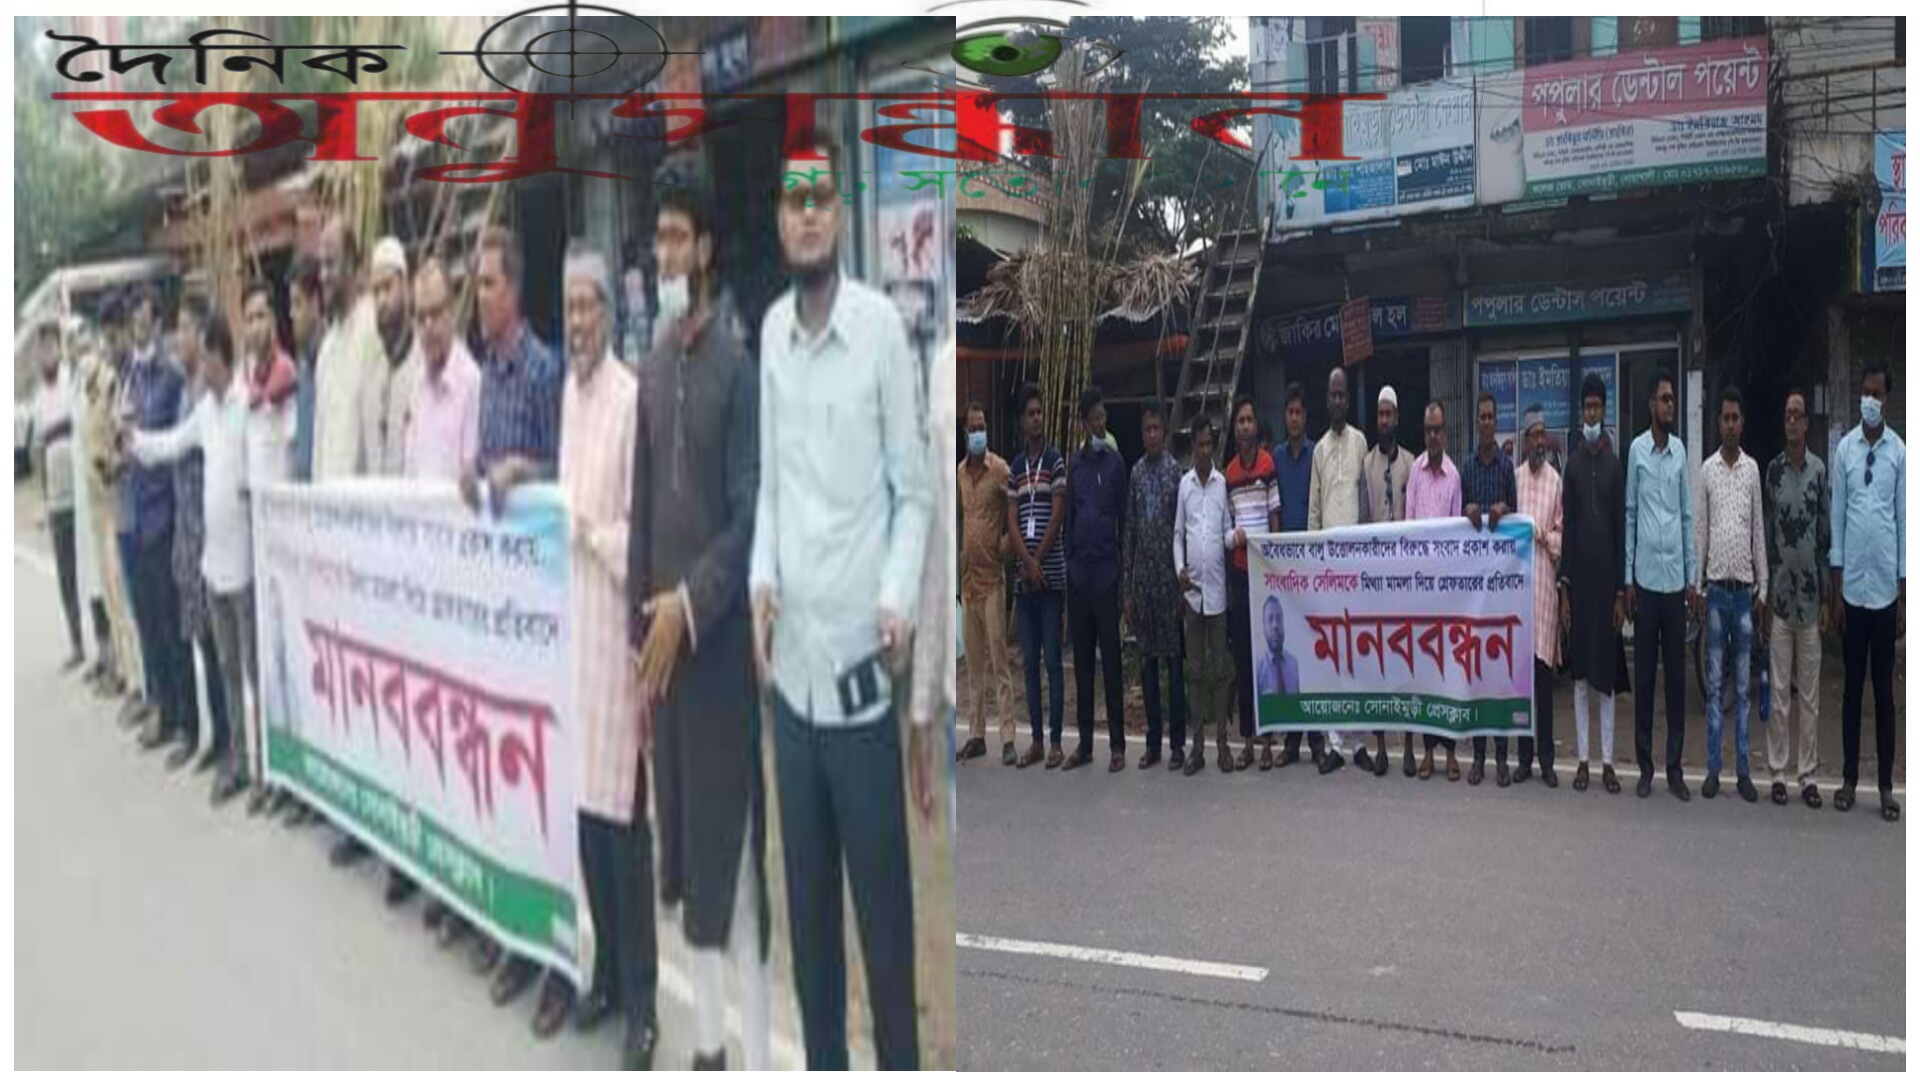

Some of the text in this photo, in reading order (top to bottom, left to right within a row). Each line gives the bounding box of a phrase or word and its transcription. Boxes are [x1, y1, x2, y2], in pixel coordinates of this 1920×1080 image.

[1531, 41, 1763, 124] পপুলার ডেন্টাল পয়েন্ট
[1263, 568, 1309, 593] সাংবাদিক
[1313, 569, 1359, 593] সেলিমকে
[1361, 571, 1383, 593] মিথ্যা
[1385, 574, 1412, 593] মামলা
[1414, 570, 1435, 592] দিয়ে
[1462, 538, 1489, 557] প্রকাশ
[1305, 607, 1523, 686] মানববন্ধন
[304, 618, 560, 847] মানববন্ধন
